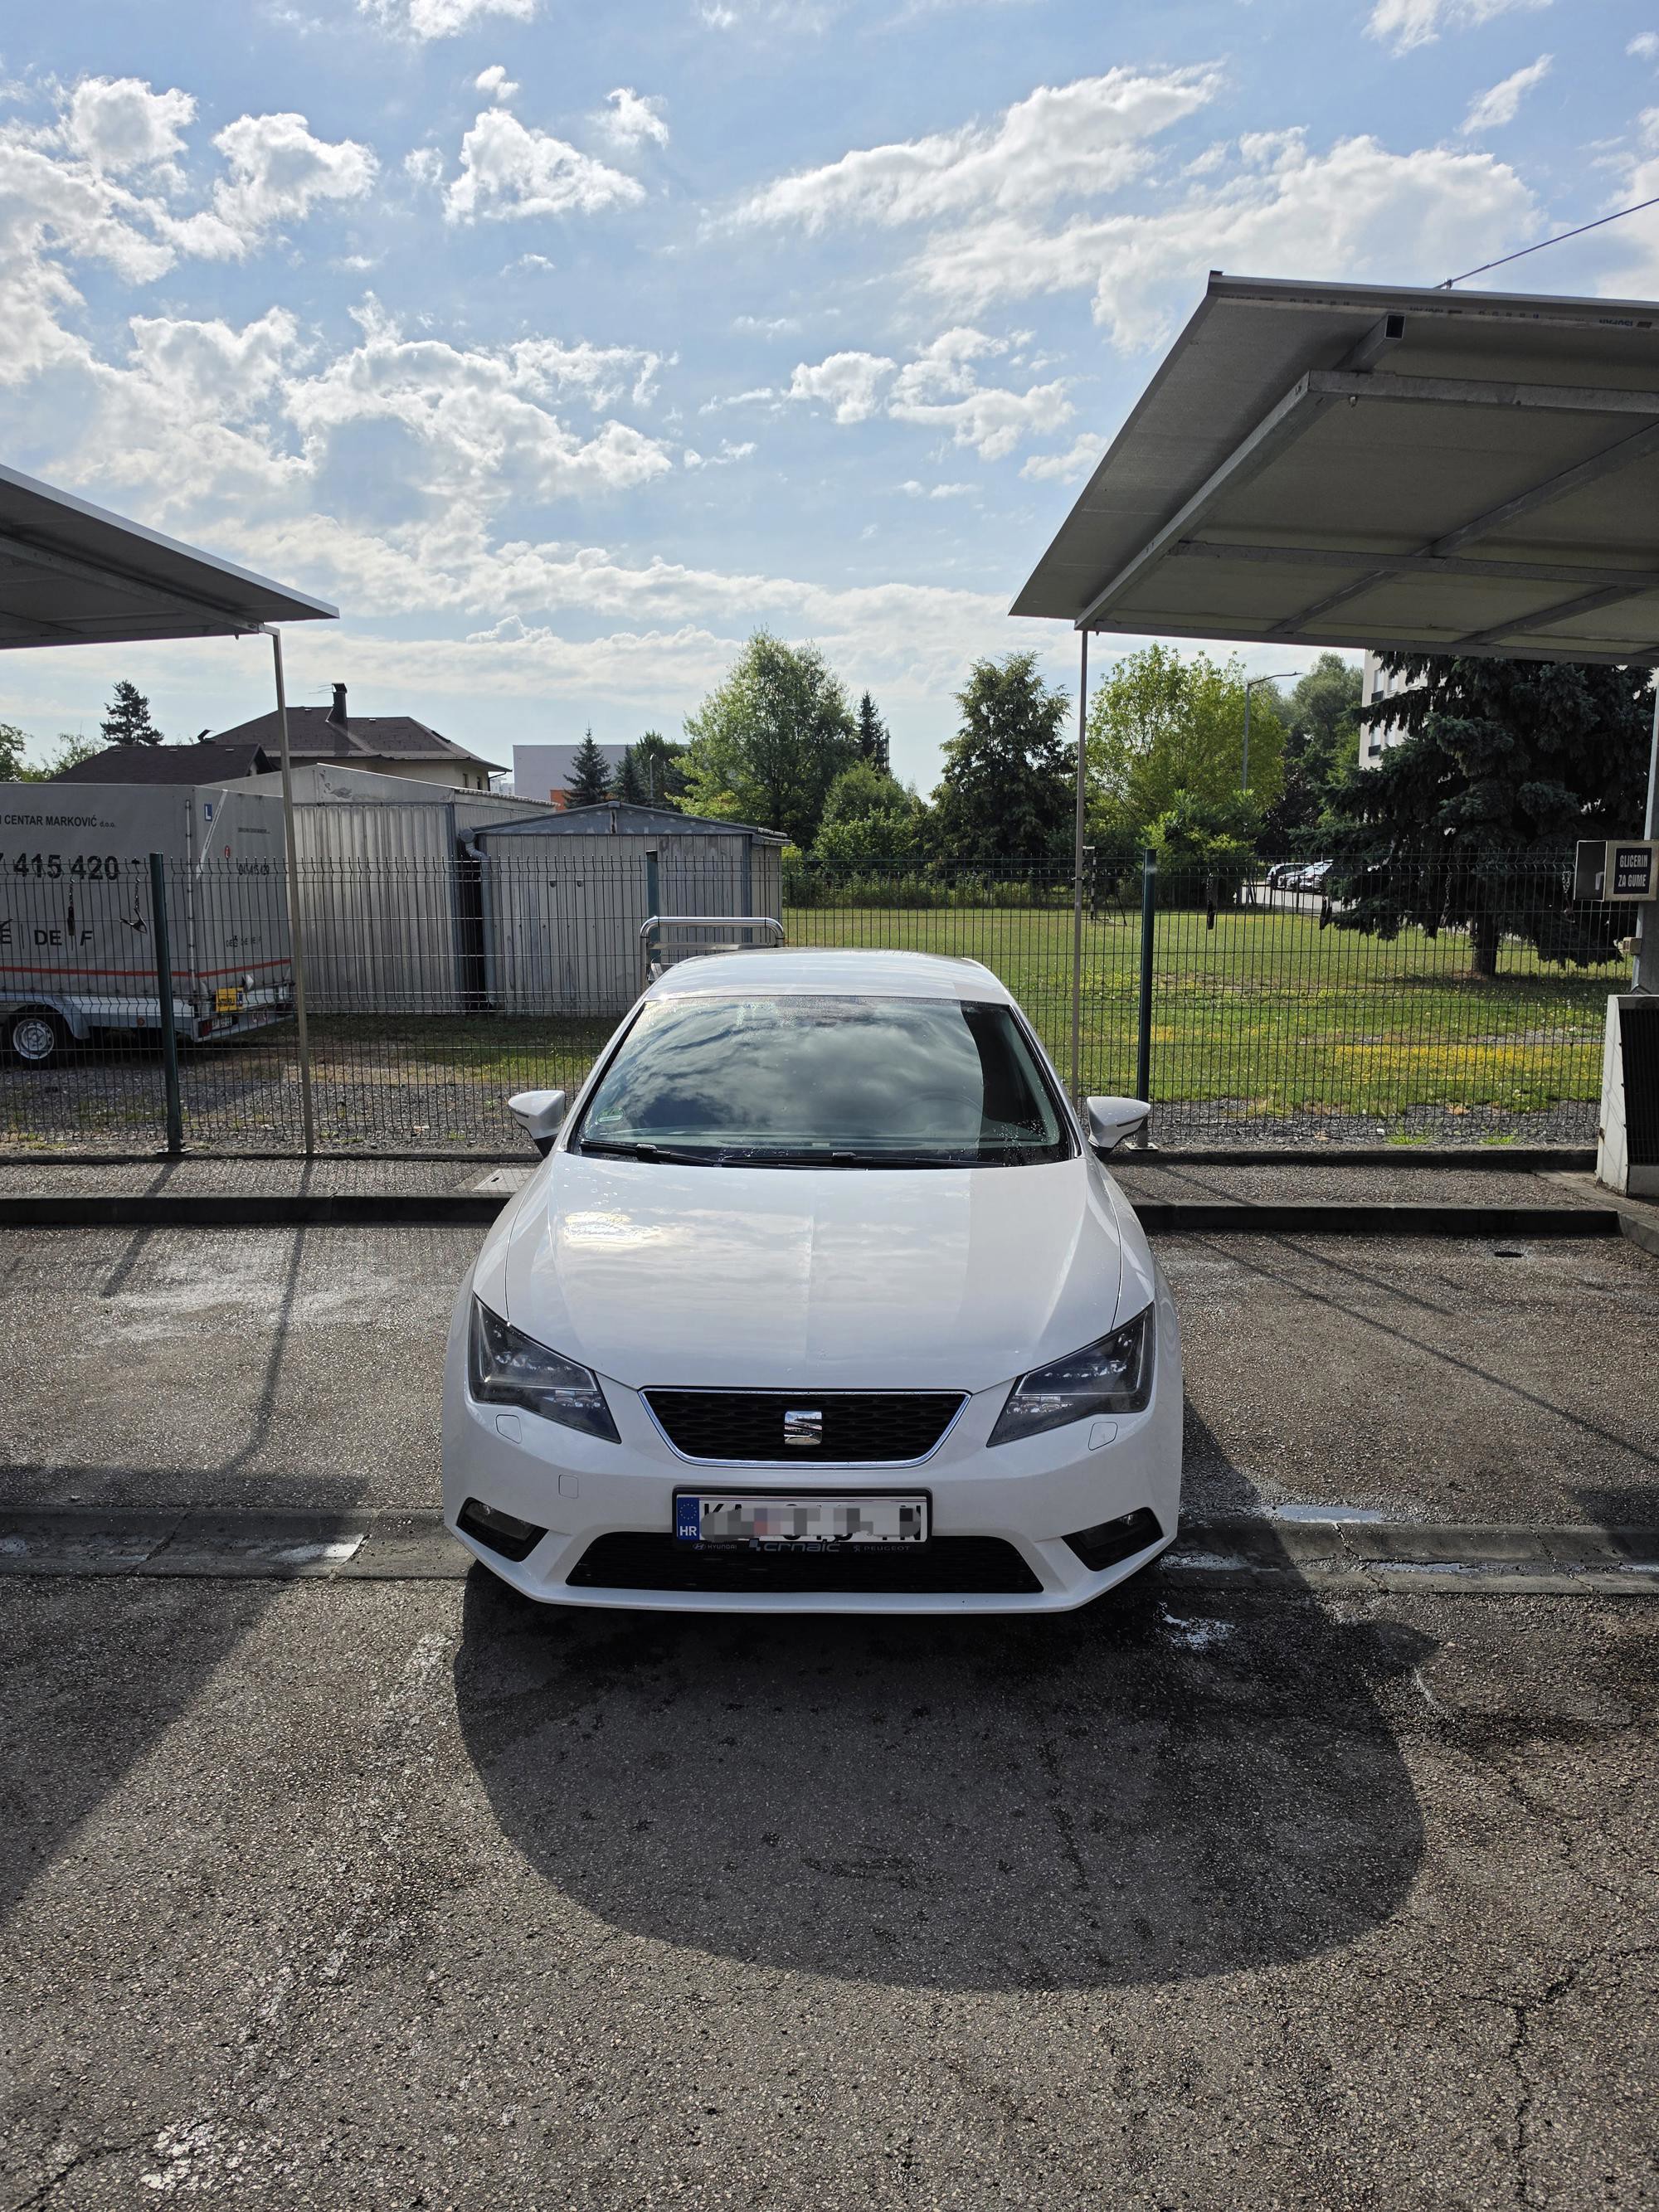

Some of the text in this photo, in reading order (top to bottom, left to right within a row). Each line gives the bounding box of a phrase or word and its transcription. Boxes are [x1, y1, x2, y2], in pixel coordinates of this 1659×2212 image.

[205, 805, 212, 819] L
[4, 814, 43, 825] CENTAR
[46, 814, 97, 827] MARKOVIĆ
[13, 853, 61, 879] 415
[71, 855, 119, 881] 420
[1620, 855, 1647, 868] GLICERIN
[1618, 875, 1646, 887] ZA GUME
[679, 1525, 697, 1536] HR
